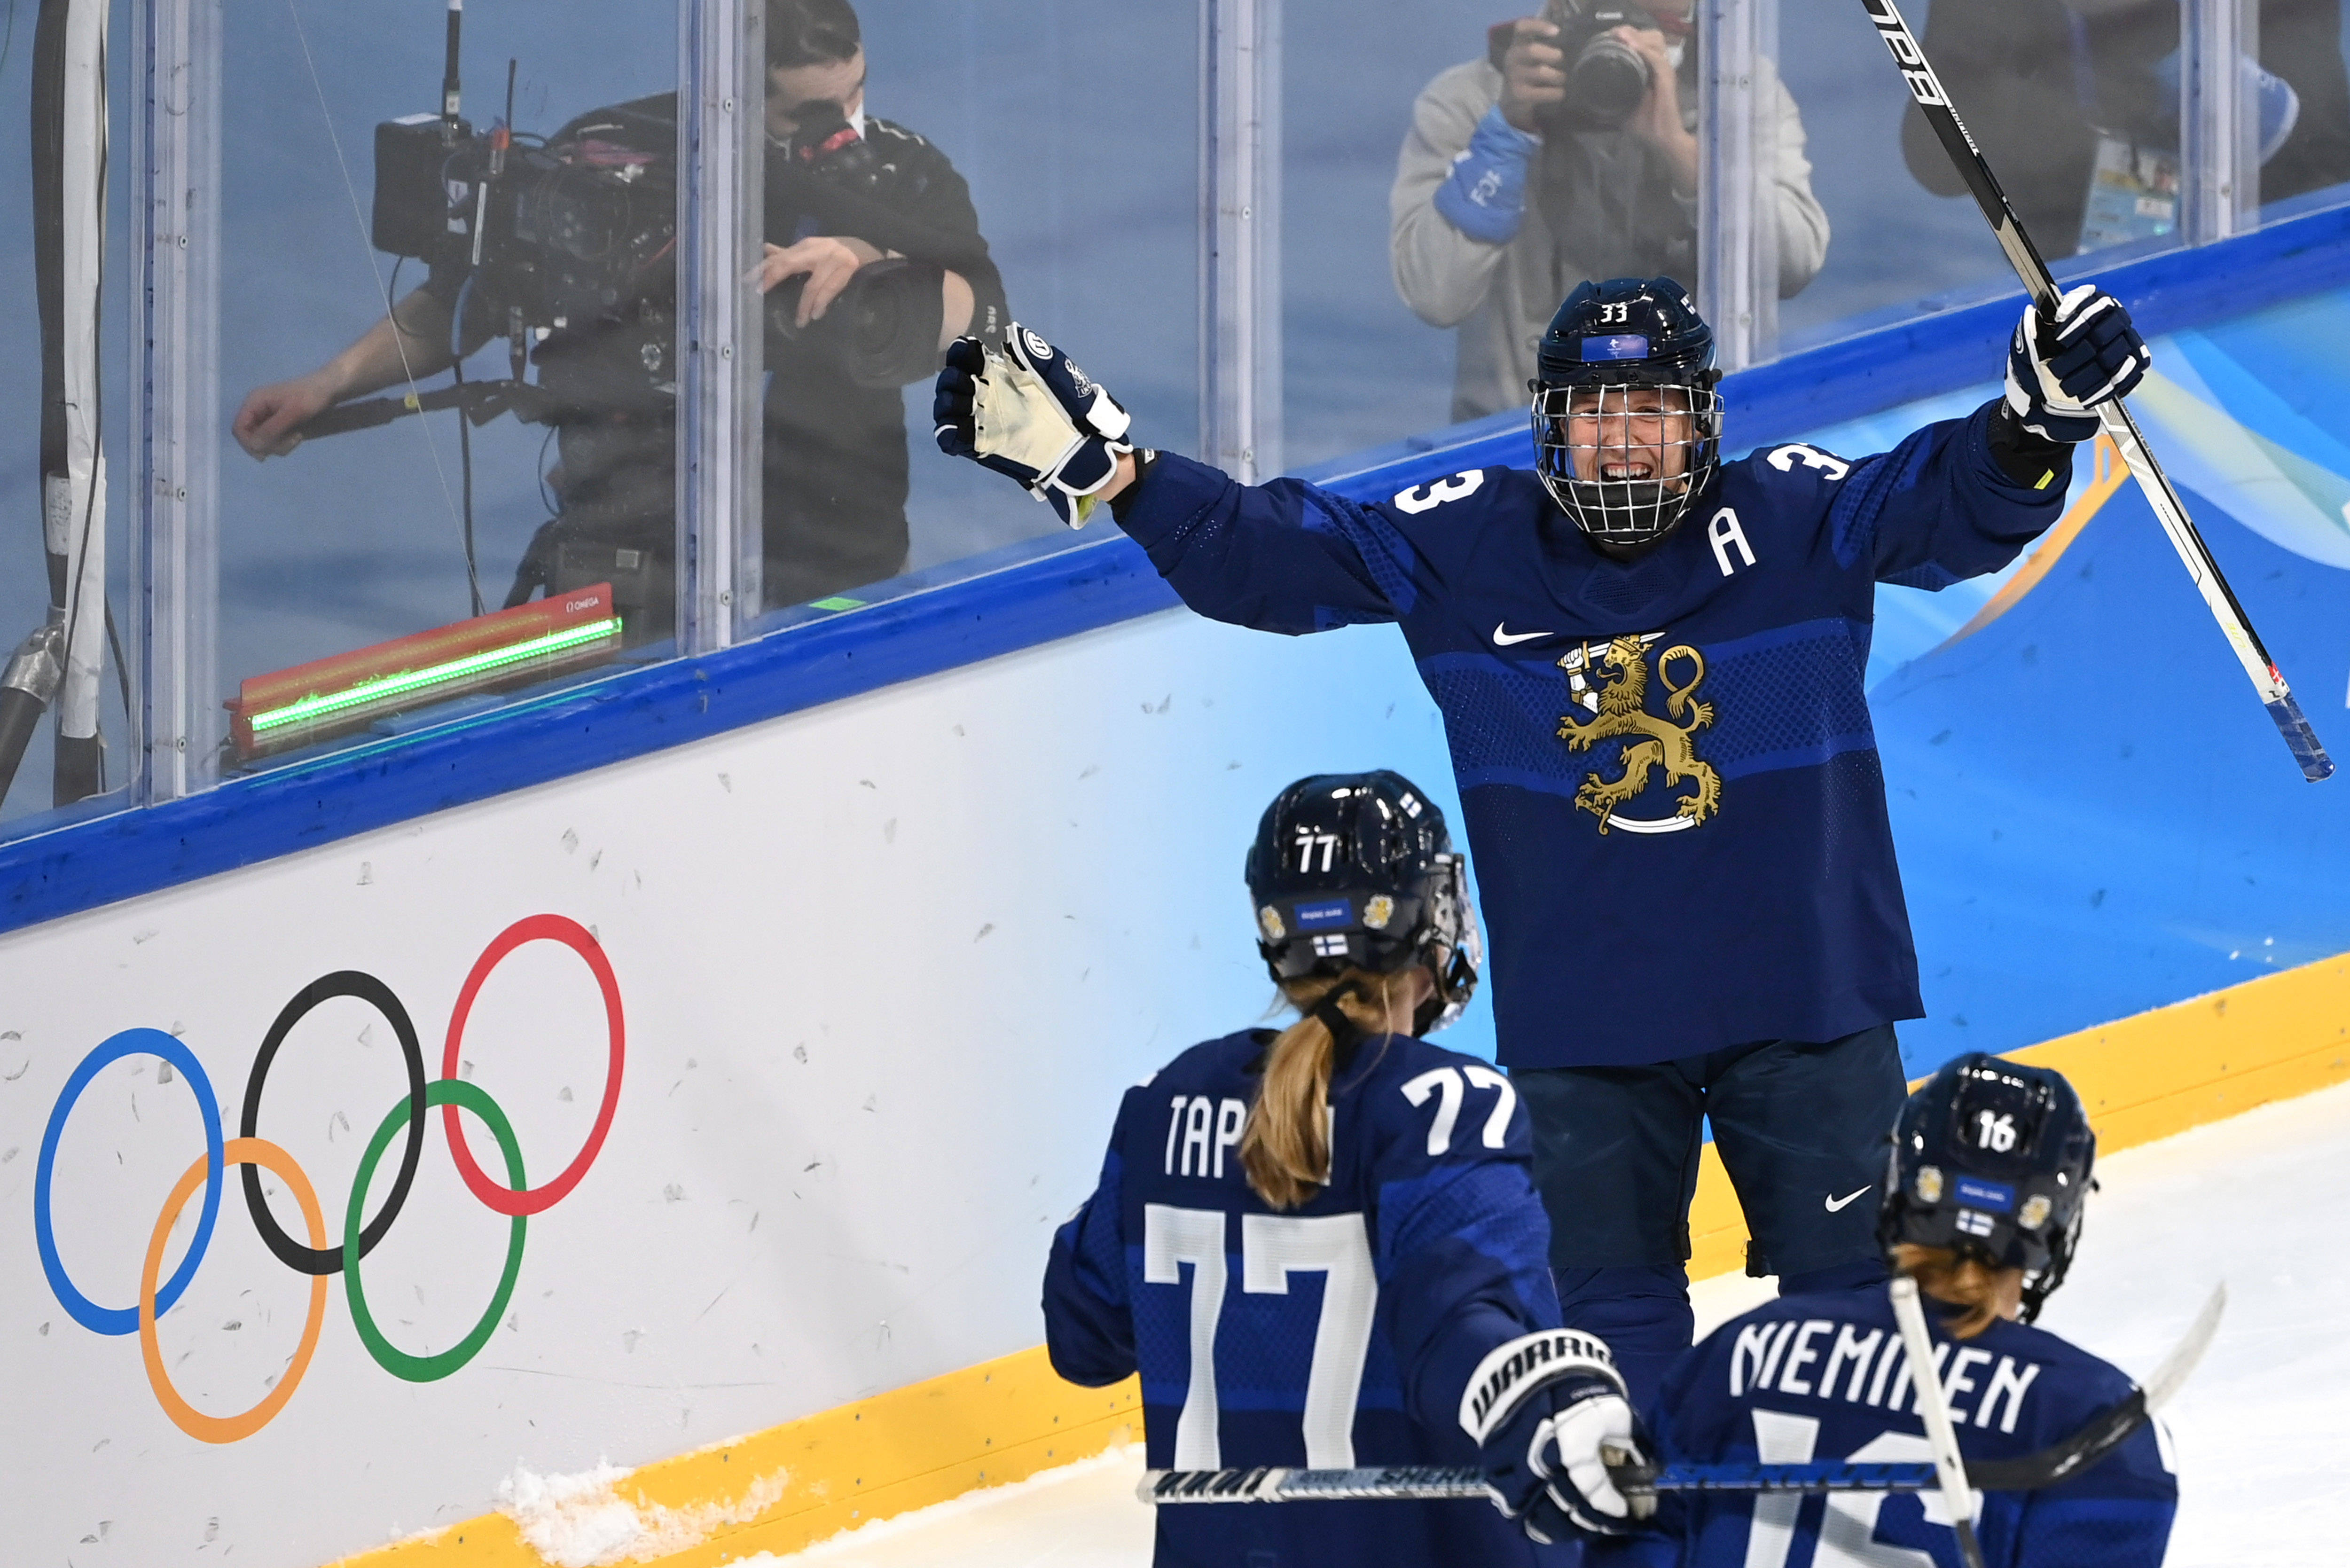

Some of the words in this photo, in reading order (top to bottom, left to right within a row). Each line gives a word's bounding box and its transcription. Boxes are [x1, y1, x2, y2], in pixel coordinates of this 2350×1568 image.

[1600, 304, 1628, 322] 33
[1708, 507, 1756, 577] A
[575, 597, 599, 610] OMEGA
[1295, 835, 1337, 873] 77
[1401, 1065, 1517, 1156] 77
[1978, 1109, 2016, 1152] 16
[1144, 1203, 1378, 1471] 77
[1743, 1408, 1983, 1568] 16
